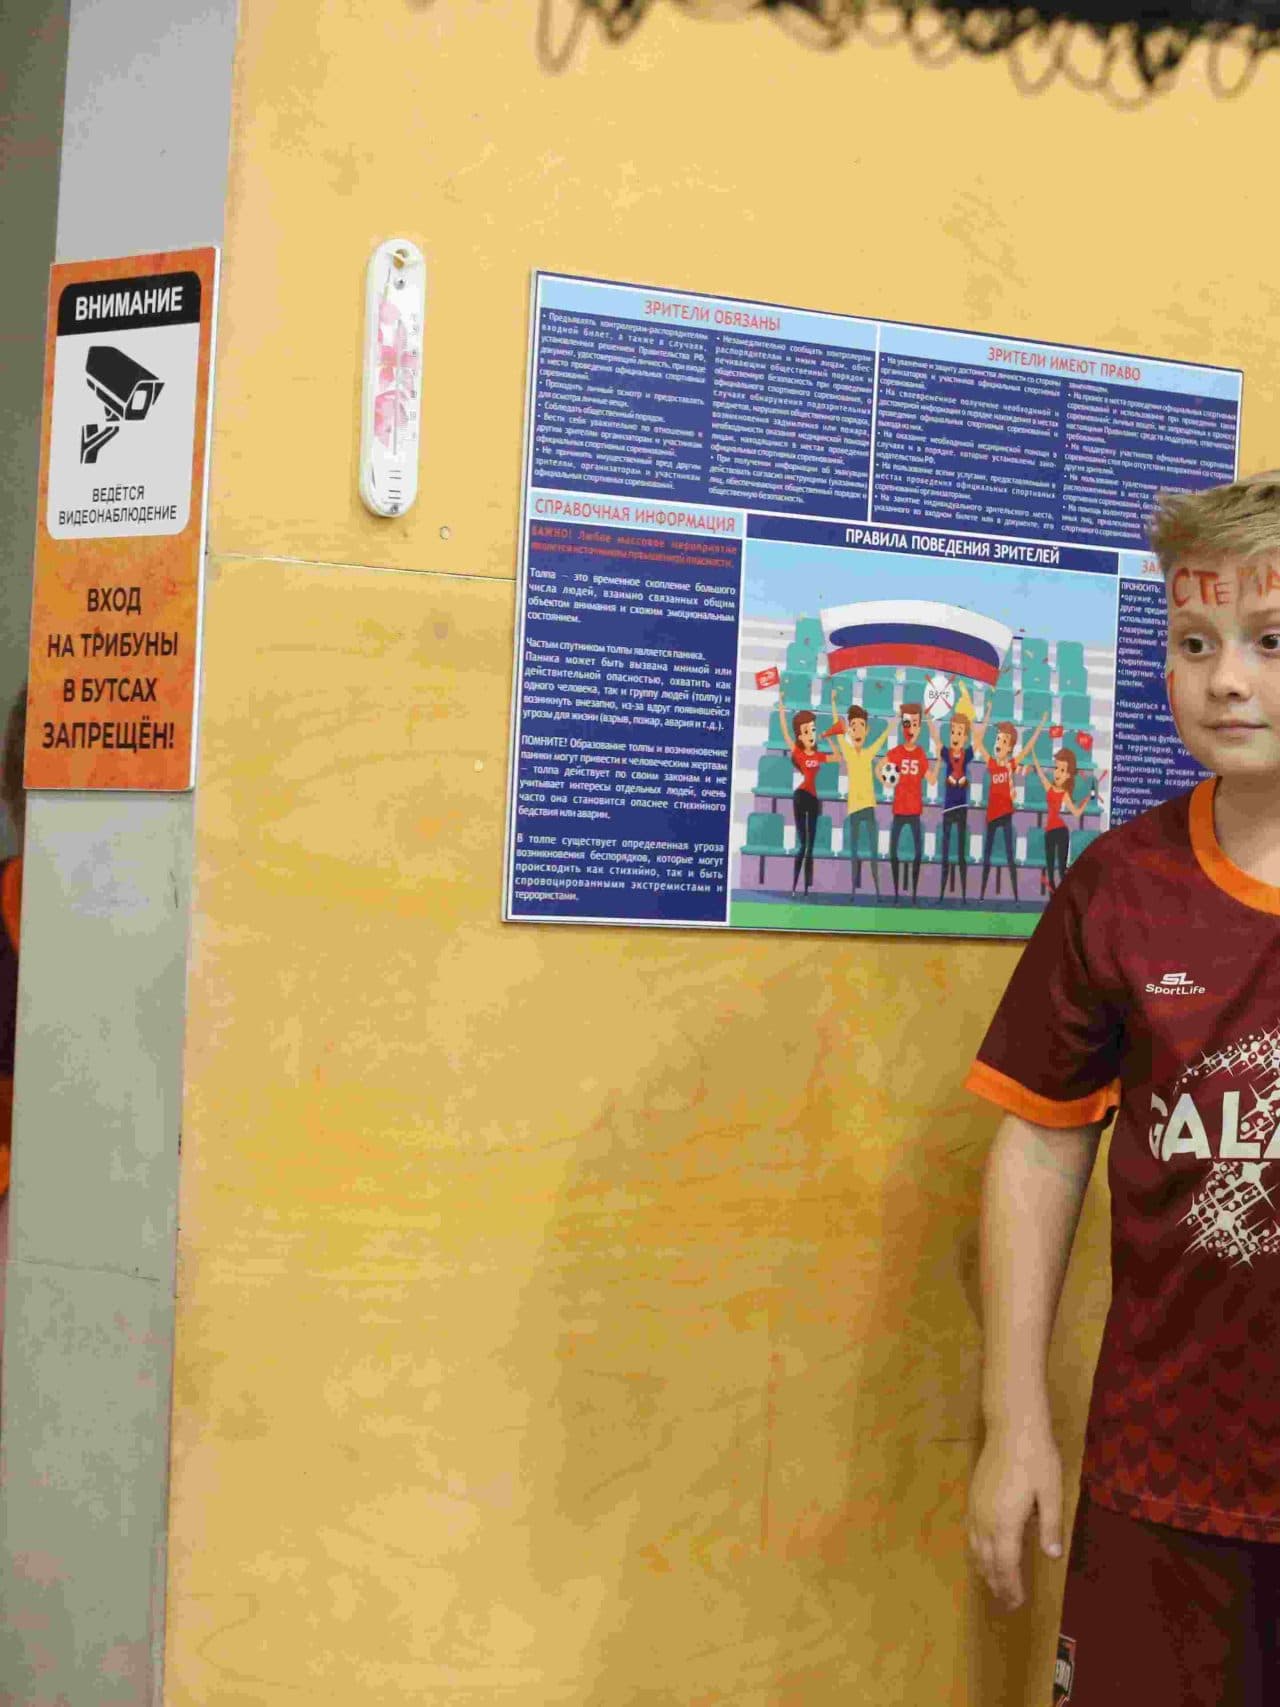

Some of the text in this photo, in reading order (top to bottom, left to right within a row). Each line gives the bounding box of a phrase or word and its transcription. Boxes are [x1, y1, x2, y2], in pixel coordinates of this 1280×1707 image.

[75, 285, 182, 321] ВНИМАНИЕ
[644, 300, 781, 331] ЗРИТЕЛИ ОБЯЗАНЫ
[987, 347, 1141, 381] ЗРИТЕЛИ ИМЕЮТ ПРАВО
[91, 484, 145, 503] ВЕДЁТСЯ
[58, 505, 177, 526] ВИДЕОНАБЛЮДЕНИЕ
[535, 498, 735, 533] СПРАВОЧНАЯ ИНФОРМАЦИЯ
[845, 528, 1060, 565] ПРАВИЛА ПОВЕДЕНИЯ ЗРИТЕЛЕЙ
[530, 567, 735, 595] Толпа это временное скопление большого
[87, 587, 142, 613] ВХОД
[529, 584, 735, 609] числа людей, взаимно связанных общим
[527, 612, 581, 623] состоянием.
[528, 598, 734, 622] объектом внимания и схожим эмоциональным
[47, 631, 179, 658] НА ТРИБУНЫ
[527, 637, 706, 660] Частым спутником толпы является паника.
[525, 652, 732, 676] Паника может быть вызвана мнимой или
[525, 666, 731, 689] действительной опасностью, охватить как
[63, 676, 157, 703] В БУТСАХ
[524, 681, 554, 692] одного
[558, 684, 600, 695] человека,
[604, 687, 618, 696] так
[629, 689, 658, 700] группу
[661, 690, 689, 700] людей
[692, 692, 722, 704] (толпу)
[725, 695, 730, 703] и
[524, 695, 730, 717] возникнуть внезапно, из-за вдруг появившейся
[42, 718, 175, 753] ЗАПРЕЩЁН!
[522, 734, 567, 748] ПОМНИТЕ!
[570, 738, 627, 751] Образование
[629, 743, 654, 753] толпы
[664, 746, 728, 757] возникновение
[533, 766, 727, 784] толпа действует по своим законам и не
[901, 759, 920, 775] 55
[520, 779, 726, 798] учитывает интересы отдельных людей, очень
[518, 805, 611, 820] бедствия или аварии.
[519, 793, 726, 812] часто она становится опаснее стихийного
[517, 833, 724, 853] В толпе существует определенная угроза
[516, 849, 723, 867] возникновения беспорядков, которые могут
[516, 863, 723, 880] происходить как стихийно, так и быть
[515, 877, 625, 889] спровоцированными
[631, 881, 711, 892] экстремистами
[515, 891, 579, 901] террористами.
[1145, 984, 1206, 995] SportLife
